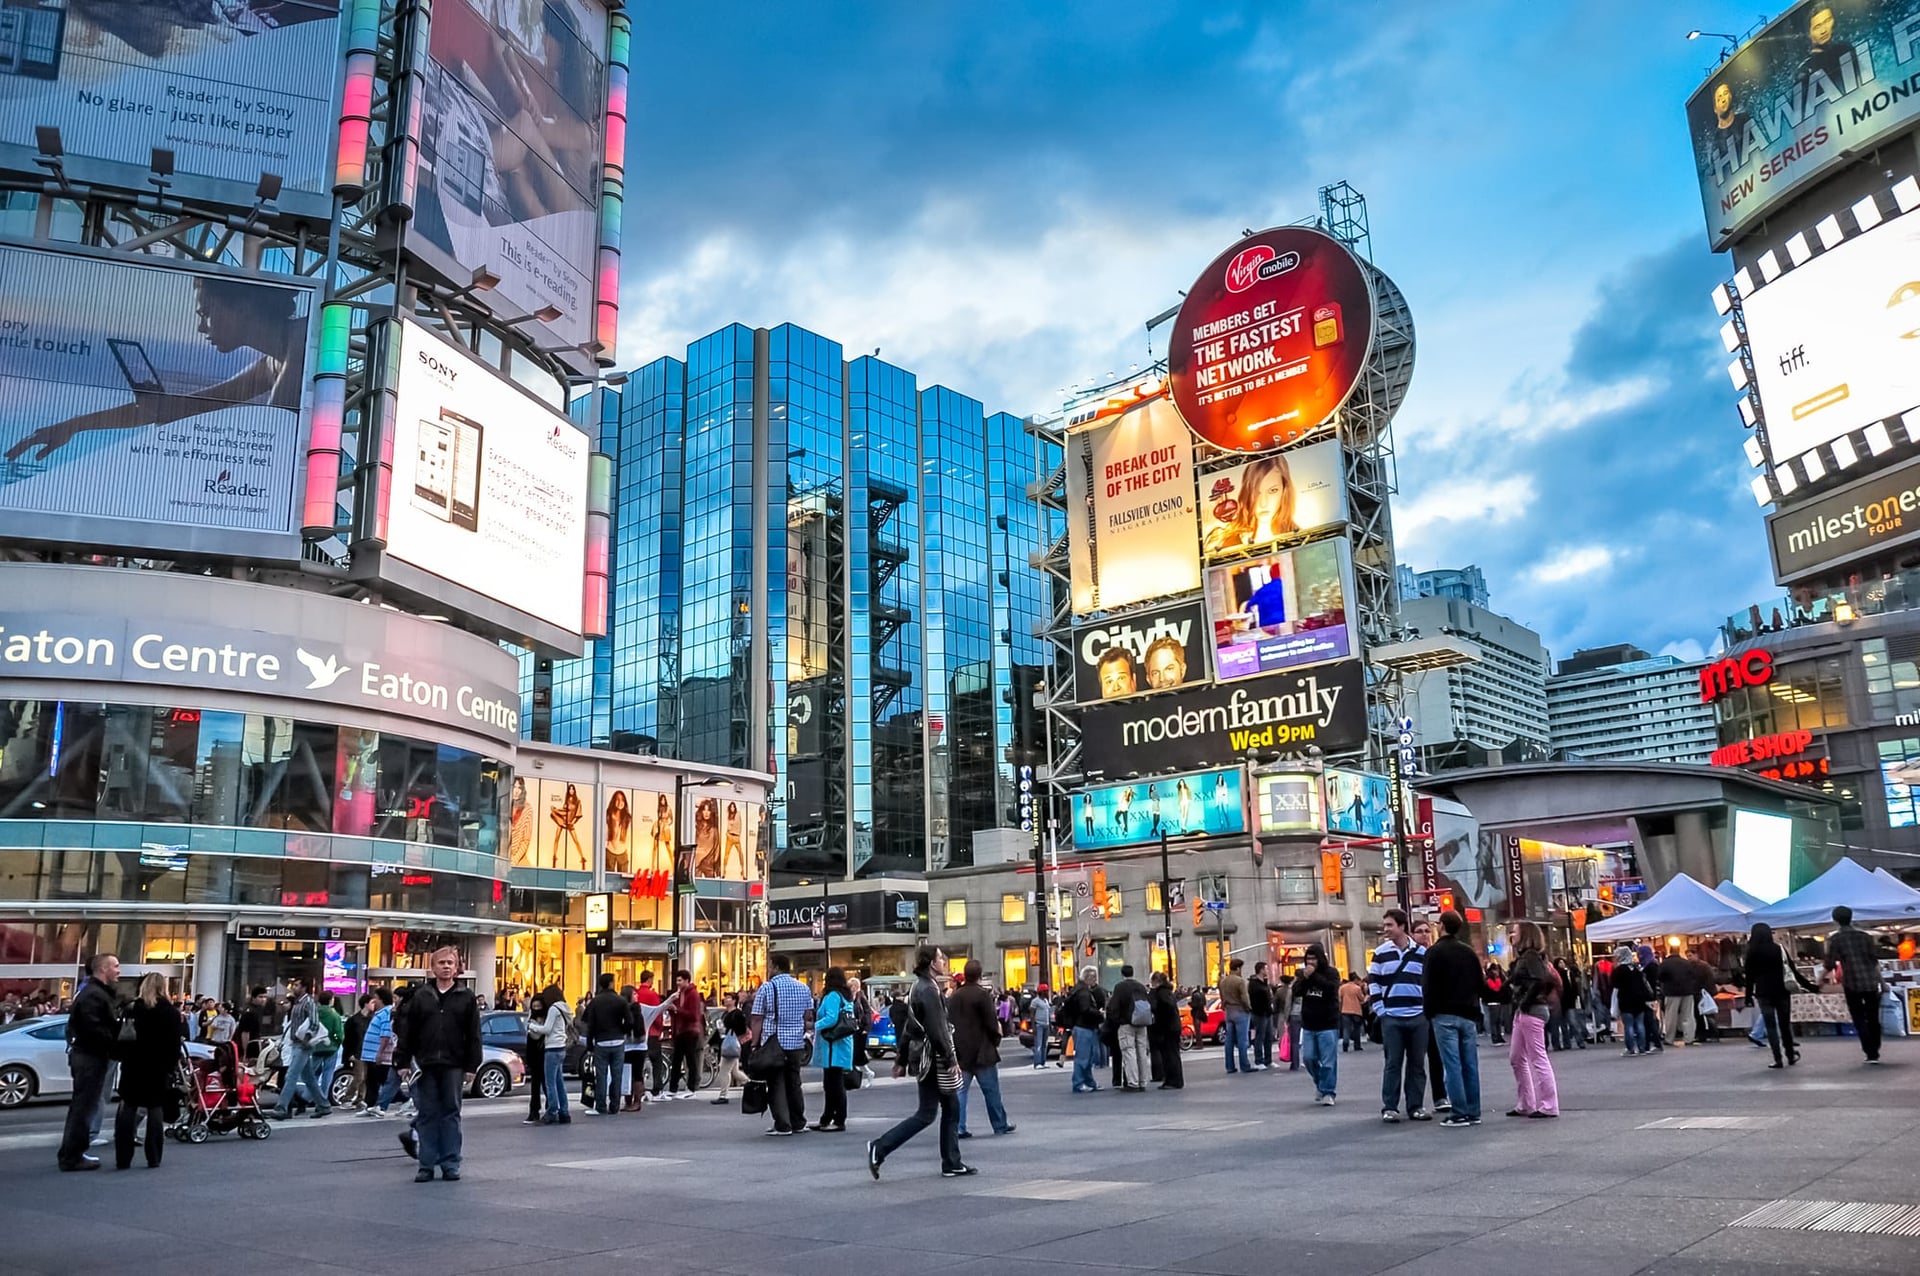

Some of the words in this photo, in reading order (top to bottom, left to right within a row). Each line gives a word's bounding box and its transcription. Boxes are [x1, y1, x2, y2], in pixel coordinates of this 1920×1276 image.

[78, 90, 103, 106] No
[108, 97, 154, 116] glare
[171, 107, 205, 125] just
[210, 114, 240, 131] like
[244, 122, 294, 139] paper
[234, 97, 252, 112] by
[256, 101, 294, 121] Sony
[1712, 39, 1876, 187] HAWAII
[1721, 175, 1755, 215] NEW
[1759, 126, 1829, 183] SERIES
[501, 236, 521, 265] This
[524, 255, 531, 273] is
[1232, 253, 1264, 286] Virgin
[1262, 258, 1293, 276] mobile
[562, 270, 578, 291] Sony
[0, 320, 29, 334] ory
[1193, 310, 1250, 341] MEMBERS
[1253, 300, 1277, 318] GET
[34, 338, 91, 356] touch
[1194, 340, 1226, 365] THE
[1230, 313, 1302, 355] FASTEST
[418, 350, 458, 382] SONY
[1196, 346, 1282, 388] NETWORK.
[1198, 393, 1212, 406] IT'S
[1214, 386, 1243, 402] BETTER
[1244, 382, 1255, 392] TO
[1256, 378, 1267, 388] BE
[1267, 376, 1274, 384] A
[1275, 364, 1308, 382] MEMBER
[157, 431, 192, 443] Clear
[196, 435, 273, 452] touchscreen
[237, 426, 249, 437] by
[251, 429, 275, 441] Sony
[130, 443, 159, 455] with
[163, 448, 179, 457] an
[183, 449, 245, 465] effortless
[249, 455, 271, 467] feel
[1105, 452, 1148, 480] BREAK
[1151, 445, 1177, 467] OUT
[1106, 480, 1122, 498] OF
[1124, 471, 1150, 494] THE
[1153, 462, 1182, 487] CITY
[1109, 506, 1151, 527] FALLSVIEW
[1153, 496, 1183, 516] CASINO
[1110, 518, 1153, 534] NIAGARA
[1154, 510, 1184, 524] FALLS
[1869, 517, 1902, 537] FOUR
[0, 627, 114, 666] aton
[131, 633, 281, 681] Centre
[361, 662, 448, 711] Eaton
[456, 686, 518, 732] Centre
[1229, 726, 1274, 752] Wed
[1276, 723, 1316, 745] 9PM
[1752, 729, 1813, 761] SHOP
[1020, 765, 1032, 832] Yonge
[1194, 790, 1215, 801] XXI
[1275, 793, 1307, 806] XXI
[1389, 758, 1399, 812] DOWNTOWN
[1129, 811, 1150, 822] XXI
[1161, 819, 1180, 831] XXI
[1096, 826, 1120, 839] XXI
[1509, 836, 1522, 896] GUESS
[258, 927, 296, 938] Dundas
